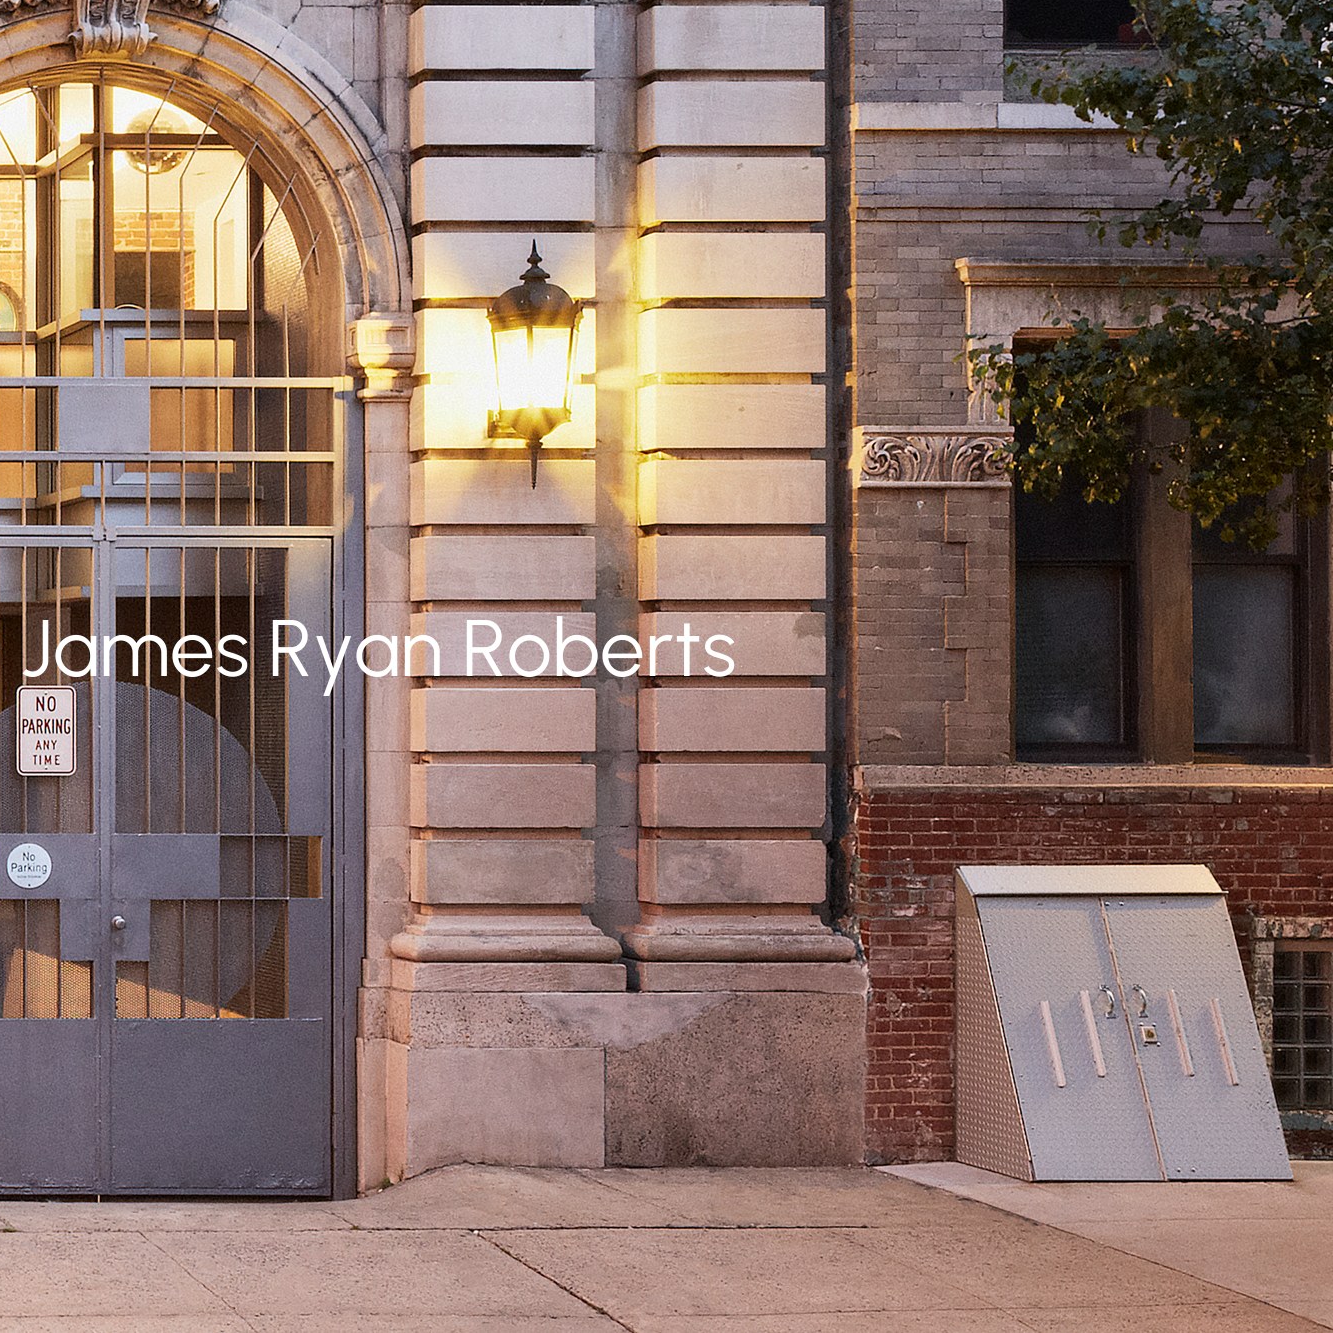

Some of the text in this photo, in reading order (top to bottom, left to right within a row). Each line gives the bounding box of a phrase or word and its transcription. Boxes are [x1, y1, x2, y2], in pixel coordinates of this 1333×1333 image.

[35, 696, 56, 712] NO
[21, 718, 71, 735] PARKING
[35, 740, 57, 751] ANY
[32, 754, 61, 766] TIME
[22, 852, 36, 862] No
[10, 862, 48, 875] Parking
